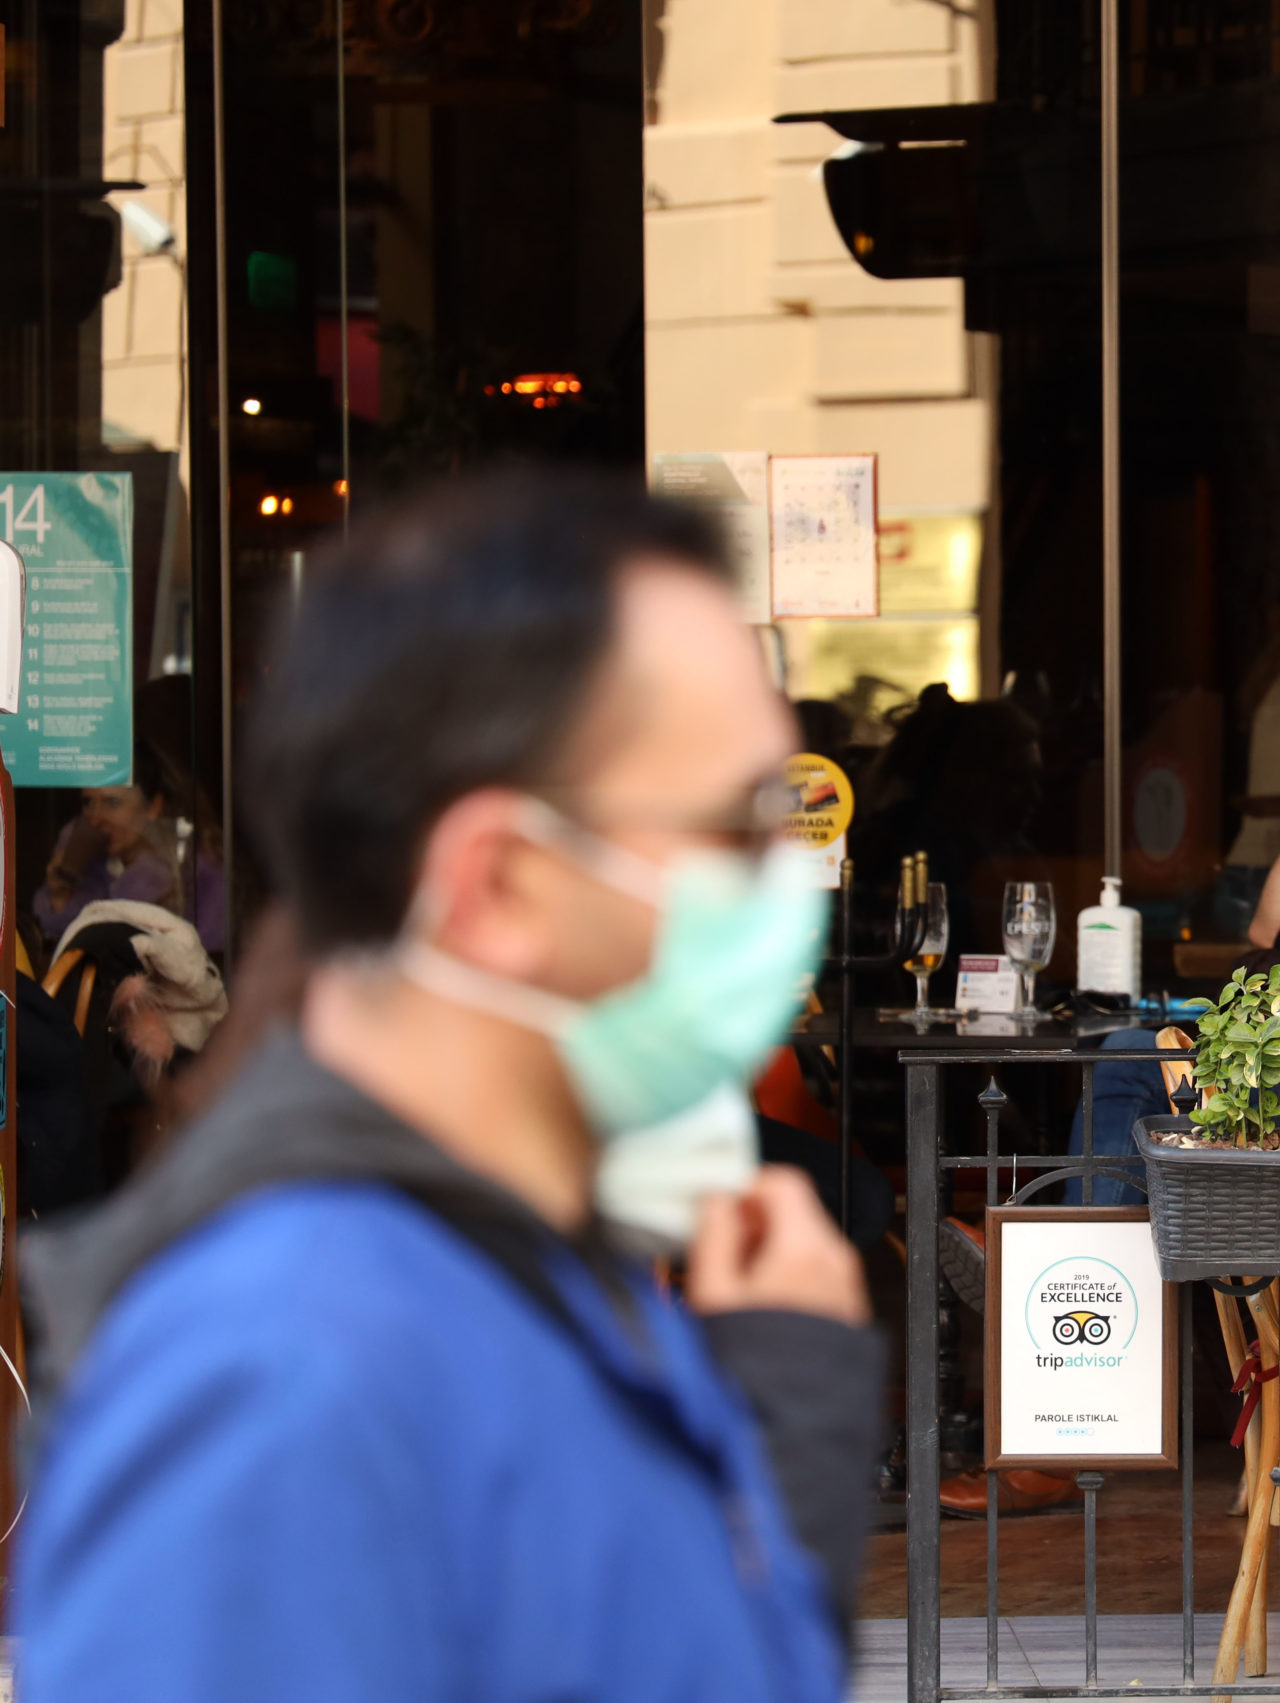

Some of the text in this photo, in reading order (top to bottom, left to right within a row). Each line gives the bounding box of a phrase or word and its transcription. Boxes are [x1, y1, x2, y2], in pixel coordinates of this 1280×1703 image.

[0, 484, 52, 544] 14
[1047, 1282, 1118, 1291] CERTIFICATE of
[1040, 1292, 1123, 1303] EXCELLENCE
[1035, 1352, 1124, 1372] tripadvisor
[1034, 1414, 1120, 1423] PAROLE ISTIKLAL
